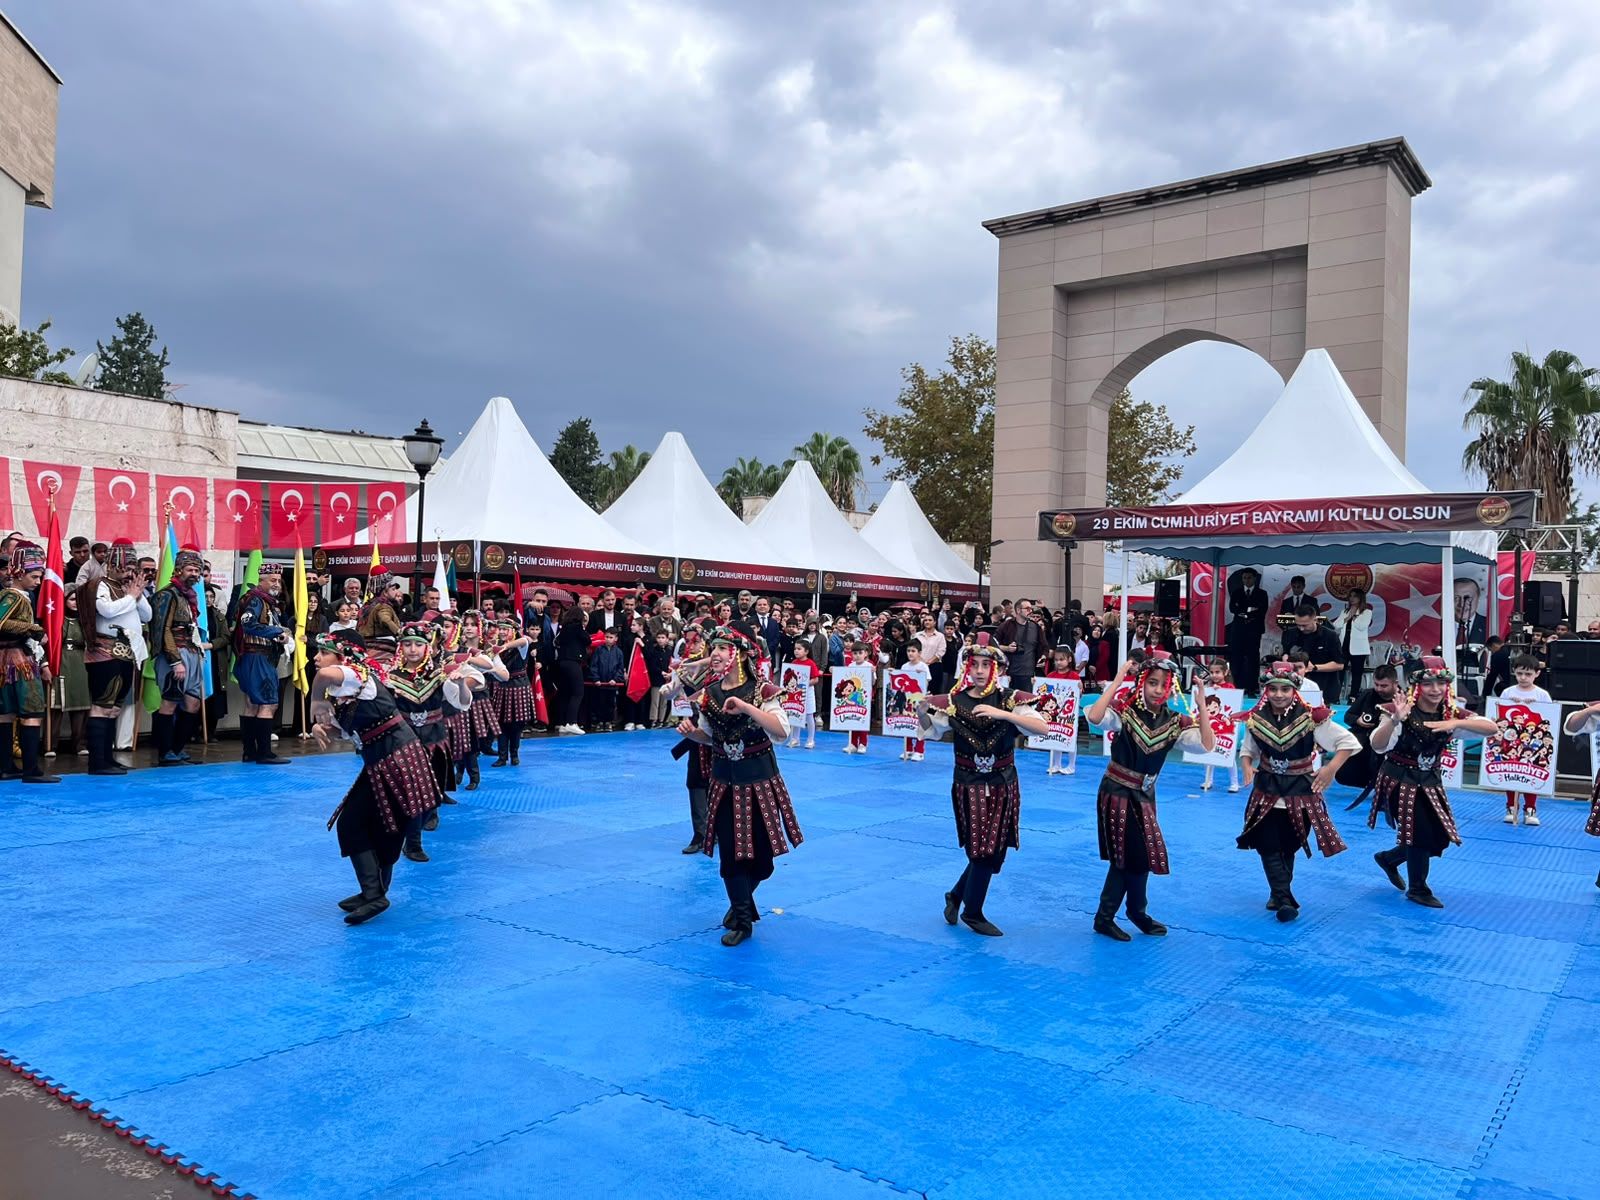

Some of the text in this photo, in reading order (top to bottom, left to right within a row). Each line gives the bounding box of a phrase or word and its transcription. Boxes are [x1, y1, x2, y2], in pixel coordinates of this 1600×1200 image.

[1093, 505, 1451, 530] 29 EKİM CUMHURİYET BAYRAMI KUTLU OLSUN
[518, 555, 538, 566] EKİM
[538, 557, 585, 569] CUMHURİYET
[585, 561, 614, 571] BAYRAMI
[614, 563, 635, 572] KUTLU
[635, 565, 656, 574] OLSUN
[696, 569, 704, 577] 29
[704, 569, 719, 578] EKİM
[718, 571, 753, 580] CUMHURİYET
[752, 573, 774, 582] BAYRAMI
[789, 576, 805, 584] OLSUN
[1488, 762, 1549, 780] CUMHURİYET
[1504, 773, 1531, 784] Halktır
